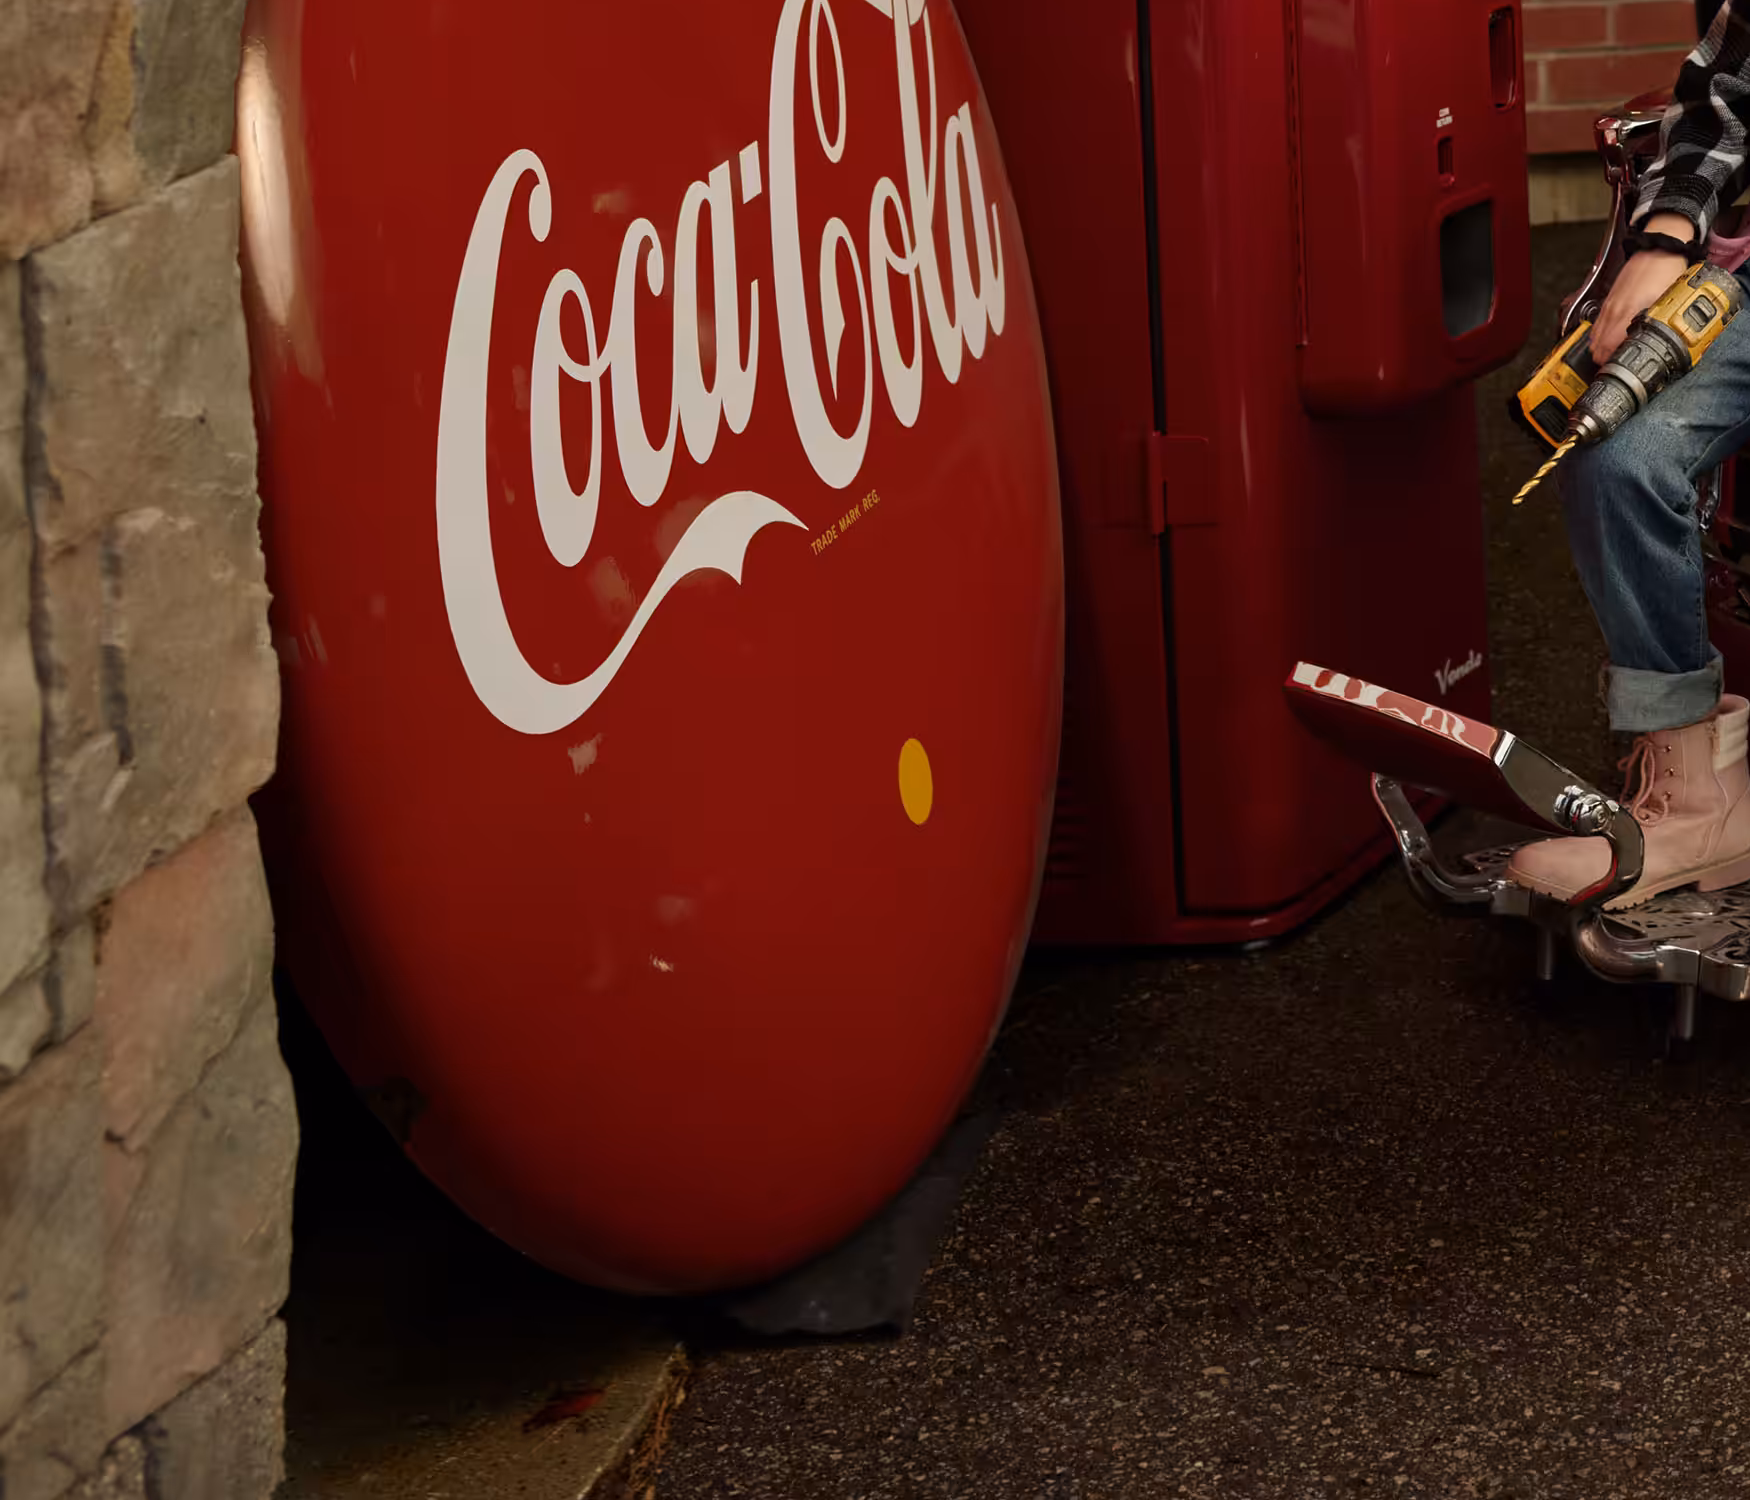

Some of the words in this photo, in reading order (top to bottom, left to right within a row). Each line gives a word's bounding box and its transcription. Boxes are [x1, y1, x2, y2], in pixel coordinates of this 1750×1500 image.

[811, 524, 838, 555] TRADE
[839, 504, 862, 533] MARK
[862, 489, 880, 512] REG.
